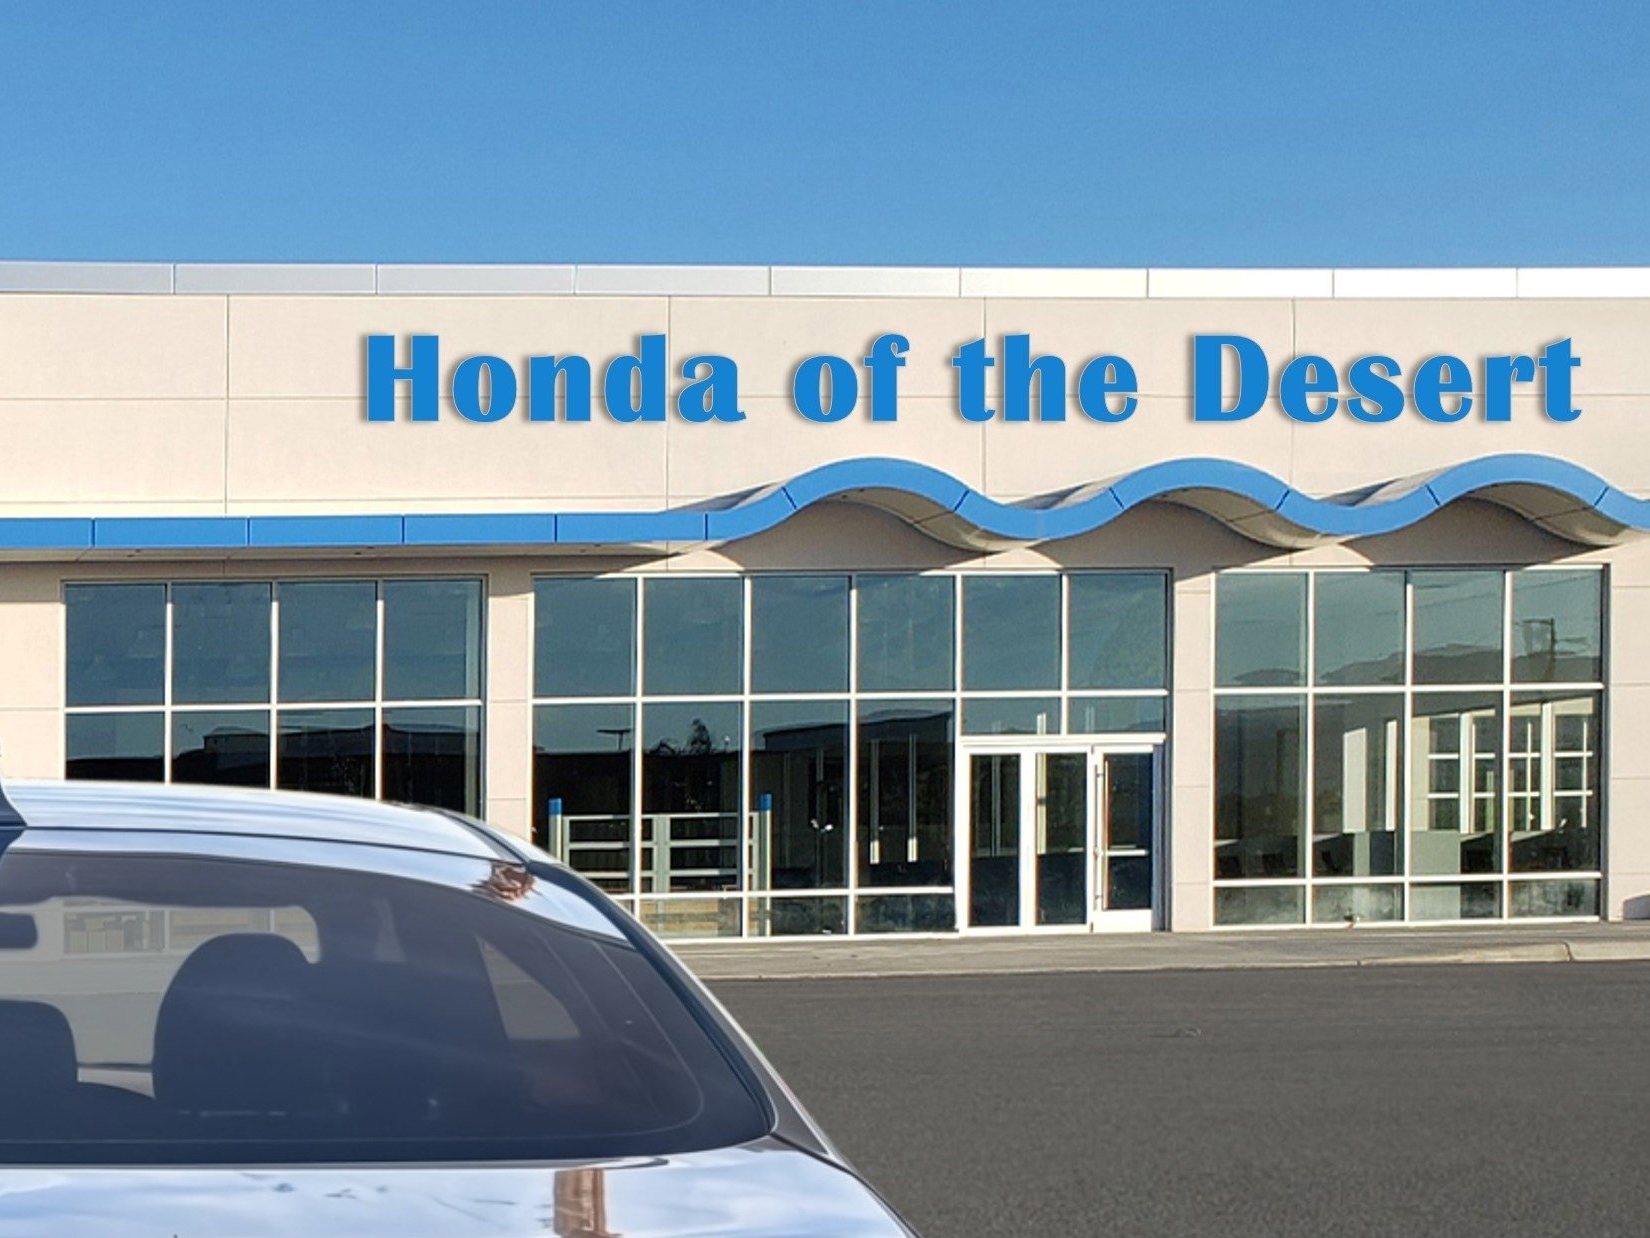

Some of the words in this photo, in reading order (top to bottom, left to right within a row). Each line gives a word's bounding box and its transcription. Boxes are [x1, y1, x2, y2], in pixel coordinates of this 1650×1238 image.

[366, 332, 748, 423] Honda
[792, 332, 911, 423] of
[951, 332, 1139, 424] the
[1193, 334, 1584, 424] Desert
